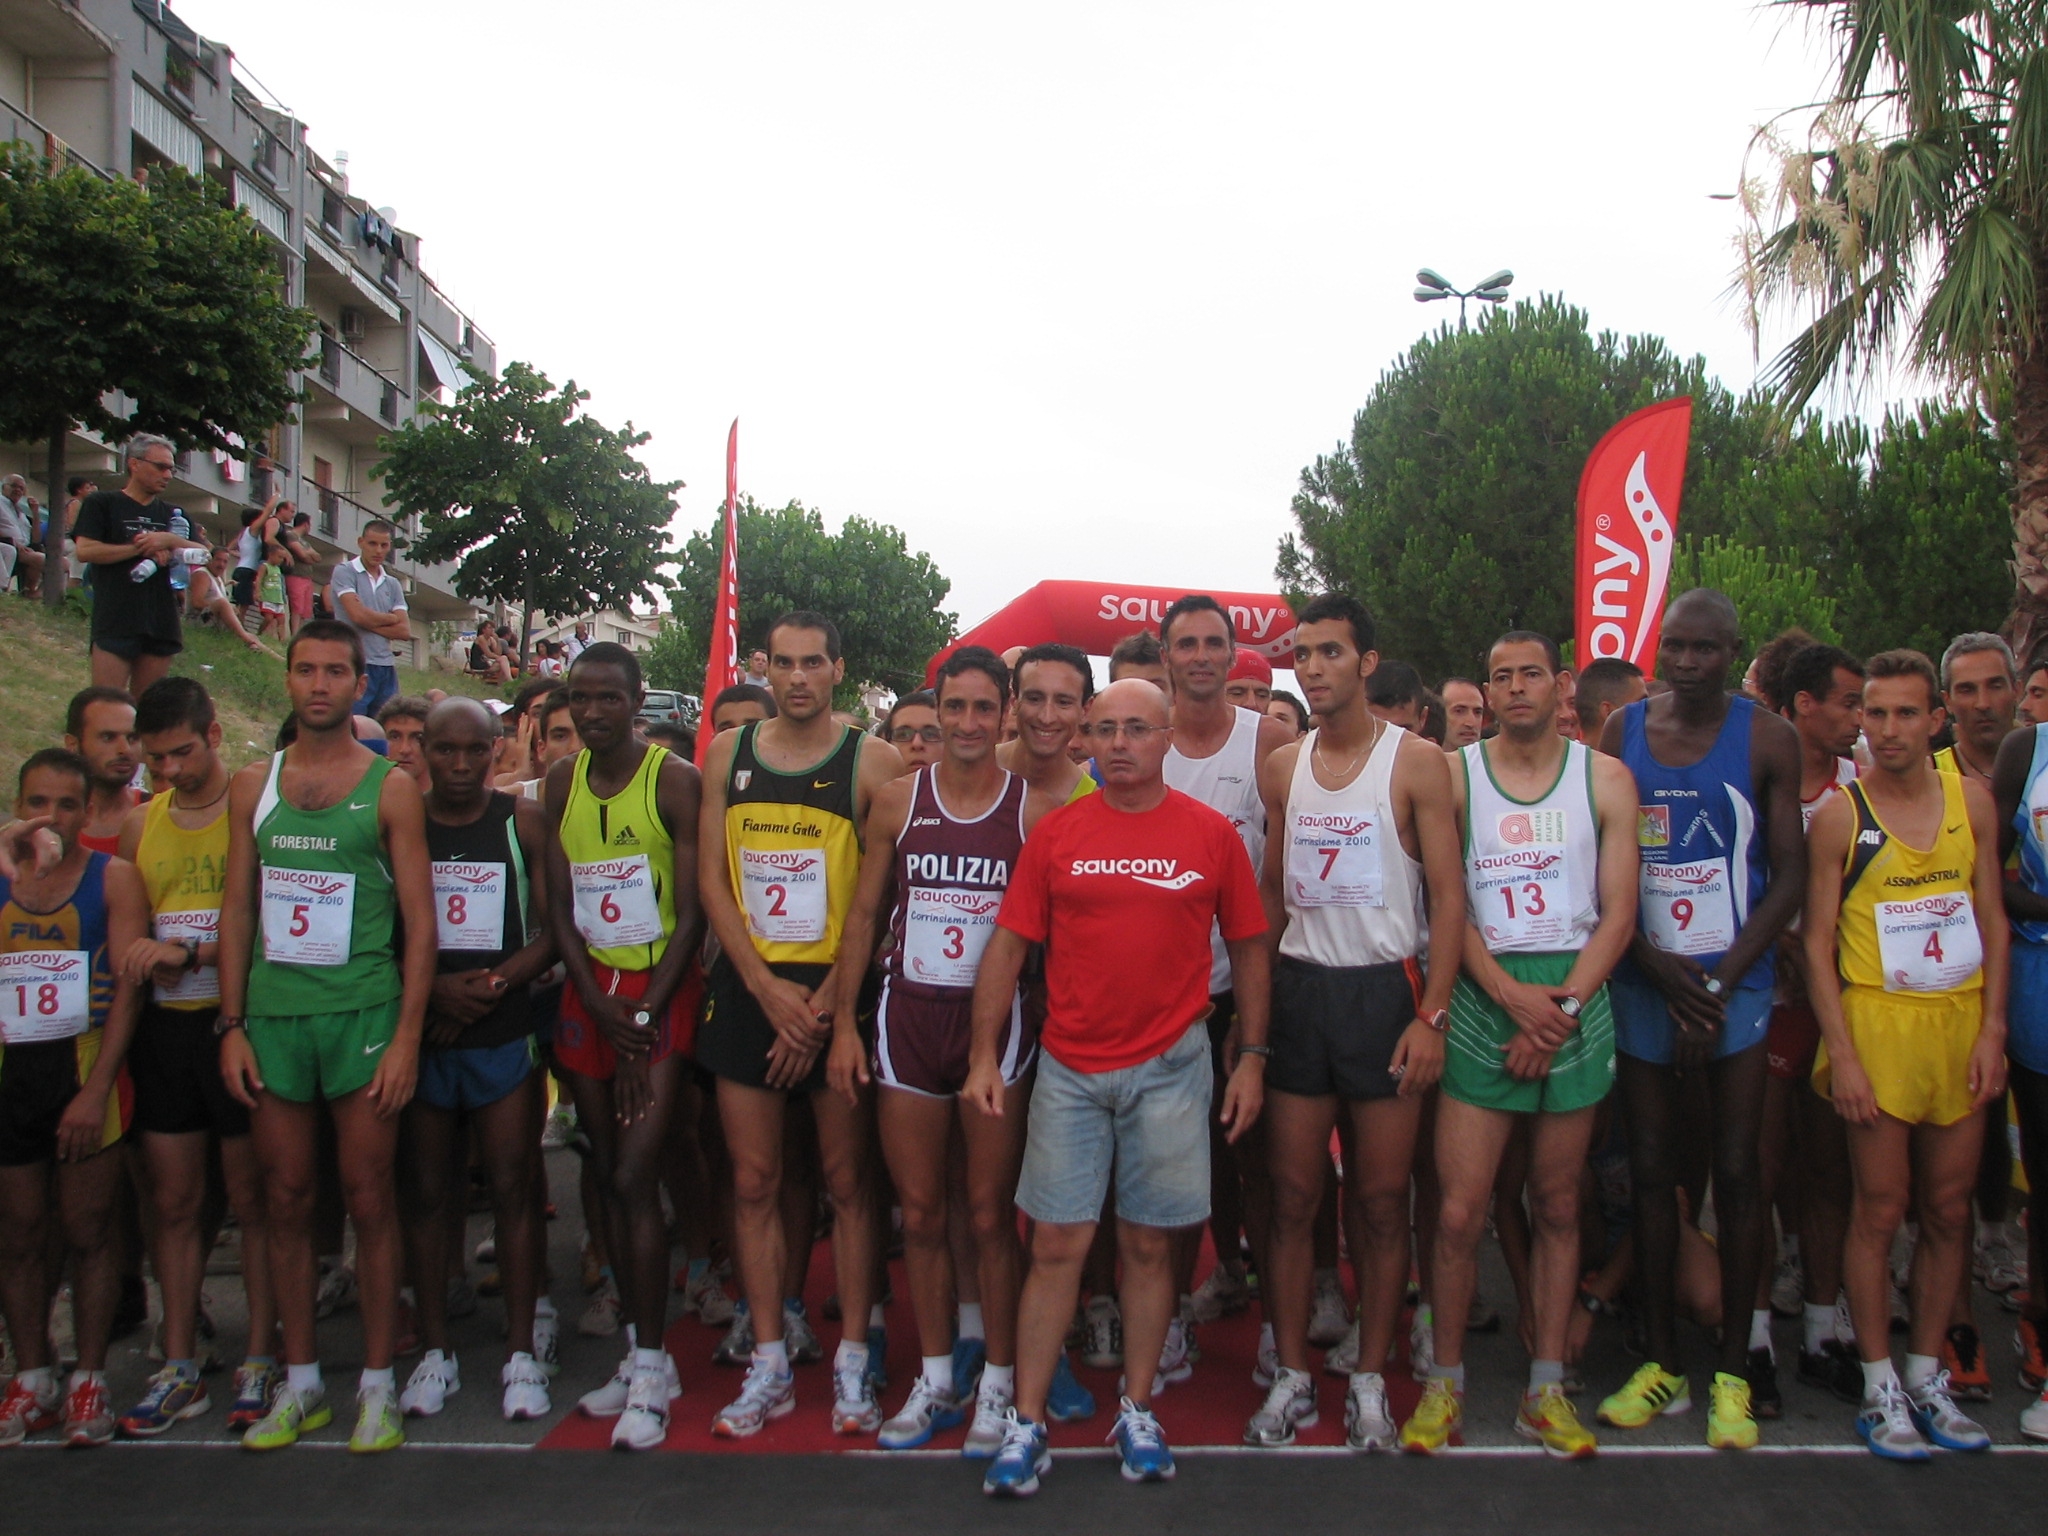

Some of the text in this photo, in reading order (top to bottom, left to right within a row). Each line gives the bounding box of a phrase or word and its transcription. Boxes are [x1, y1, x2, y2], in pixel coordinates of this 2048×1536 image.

[1098, 594, 1277, 639] sauny
[1654, 789, 1698, 797] GIVOVA
[742, 818, 789, 834] Fiamme
[1297, 815, 1353, 829] saucony
[272, 835, 338, 851] FORESTALE
[1294, 836, 1371, 846] Corrinsieme 2010
[743, 851, 800, 865] saucony
[1070, 858, 1177, 877] saucony
[1318, 848, 1341, 881] 7
[1475, 850, 1542, 871] saucony
[268, 869, 329, 887] saucony
[573, 861, 625, 876] saucony
[791, 872, 817, 882] 2010
[906, 853, 1008, 886] POLIZIA
[1646, 863, 1703, 879] saucony
[1883, 868, 1961, 887] ASSINDUSTRIA
[473, 884, 497, 893] 2010
[620, 878, 644, 890] 2010
[1475, 869, 1559, 891] Corrinsieme 2010
[264, 890, 344, 906] Corrinsieme 2010
[914, 890, 982, 907] saucony
[1643, 882, 1721, 898] Corrinsieme 2010
[447, 893, 467, 925] 8
[600, 892, 621, 924] 6
[765, 884, 787, 917] 2
[1500, 882, 1546, 919] 13
[1884, 896, 1948, 915] saucony
[160, 912, 213, 926] saucony
[289, 904, 310, 937] 5
[911, 910, 996, 925] Corrinsieme 2010
[1670, 898, 1694, 931] 9
[10, 922, 66, 941] FILA
[1884, 915, 1967, 935] Corrinsieme 2010
[942, 926, 965, 959] 3
[1923, 930, 1944, 964] 4
[52, 971, 79, 982] 2010
[16, 982, 59, 1017] 18
